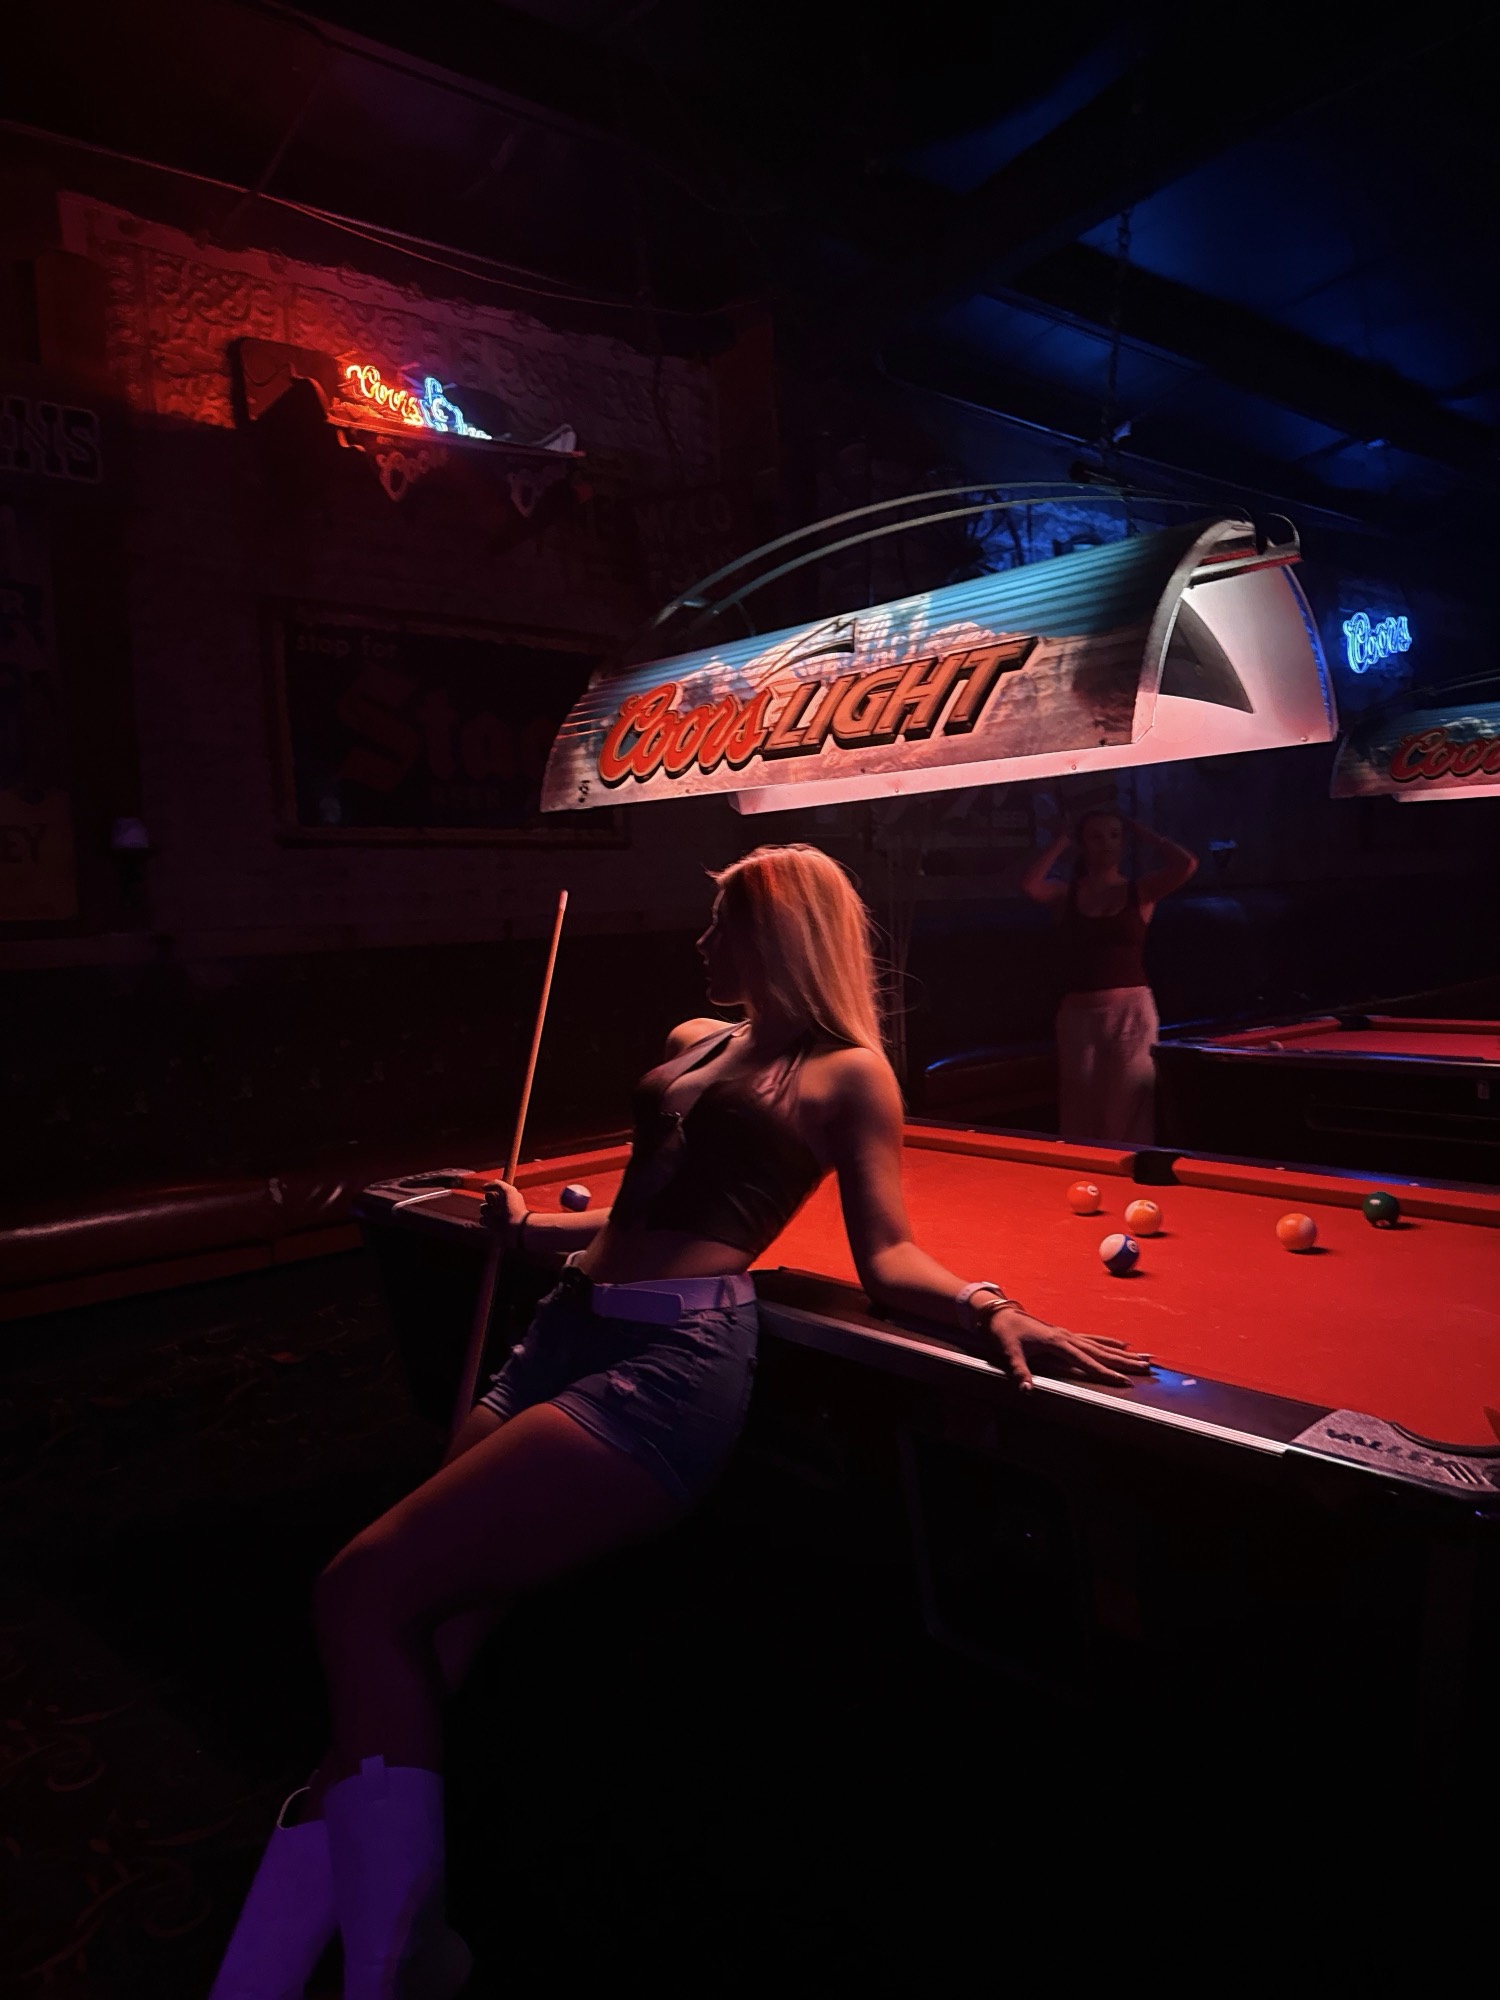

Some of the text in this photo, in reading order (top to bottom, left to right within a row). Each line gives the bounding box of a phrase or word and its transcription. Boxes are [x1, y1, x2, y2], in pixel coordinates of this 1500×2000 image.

[1343, 612, 1412, 673] Coors
[598, 636, 1038, 788] Coors LIGHT
